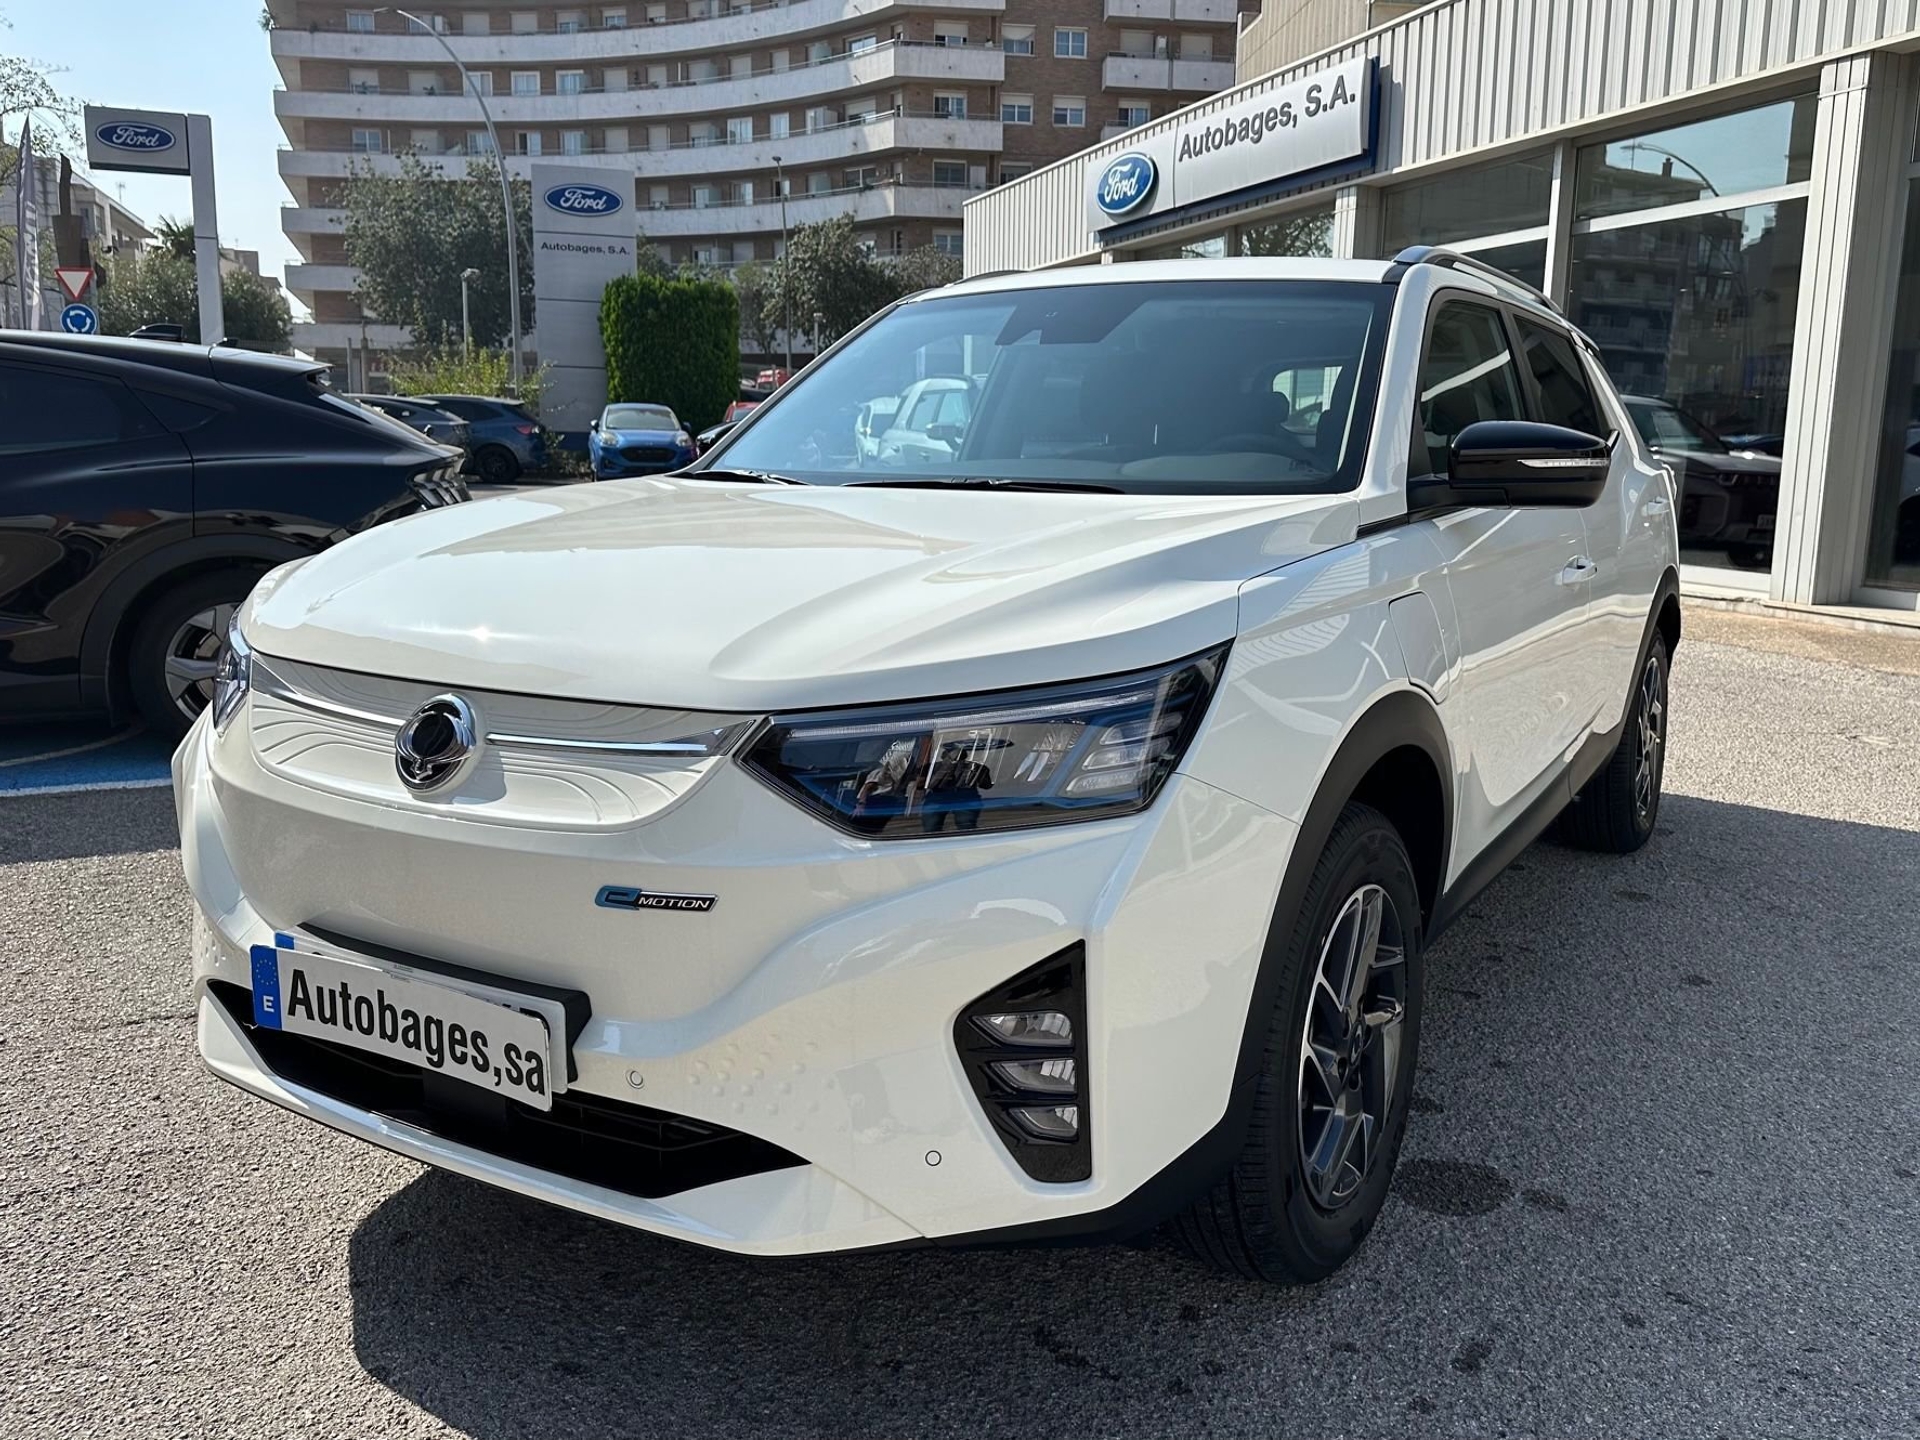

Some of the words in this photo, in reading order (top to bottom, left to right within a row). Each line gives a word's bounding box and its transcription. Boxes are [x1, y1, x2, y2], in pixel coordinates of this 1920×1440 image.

[1178, 101, 1298, 163] Autobages,
[1304, 74, 1356, 118] S.A.
[112, 126, 160, 148] Ford
[1104, 161, 1139, 204] Ford
[559, 187, 607, 211] Ford
[541, 241, 606, 255] Autobages,
[607, 245, 630, 256] S.A.
[262, 994, 275, 1013] E
